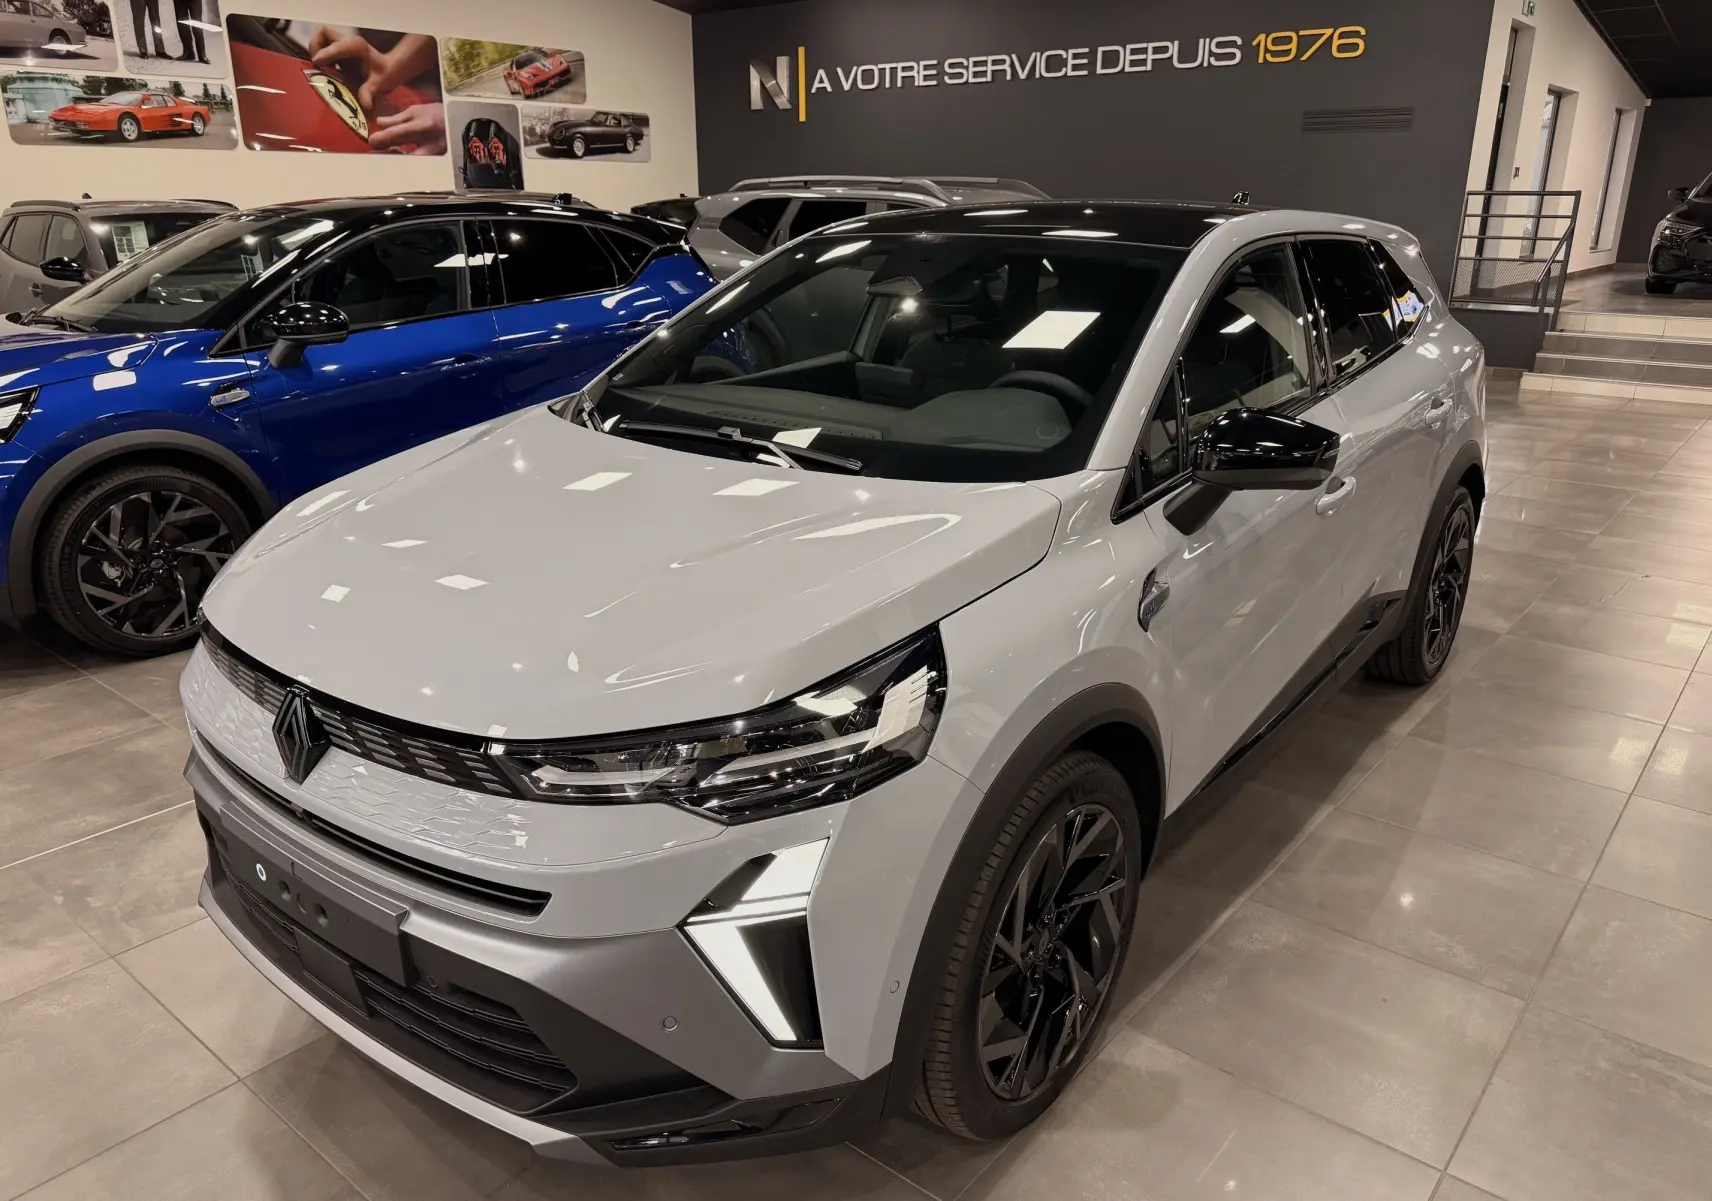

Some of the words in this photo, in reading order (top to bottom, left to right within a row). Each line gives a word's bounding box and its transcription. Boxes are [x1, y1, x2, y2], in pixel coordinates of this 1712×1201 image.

[749, 56, 792, 110] N
[811, 68, 833, 94] A
[836, 59, 939, 91] VOTRE
[943, 47, 1090, 85] SERVICE
[1095, 35, 1243, 75] DEPUIS
[1251, 25, 1368, 64] 1976
